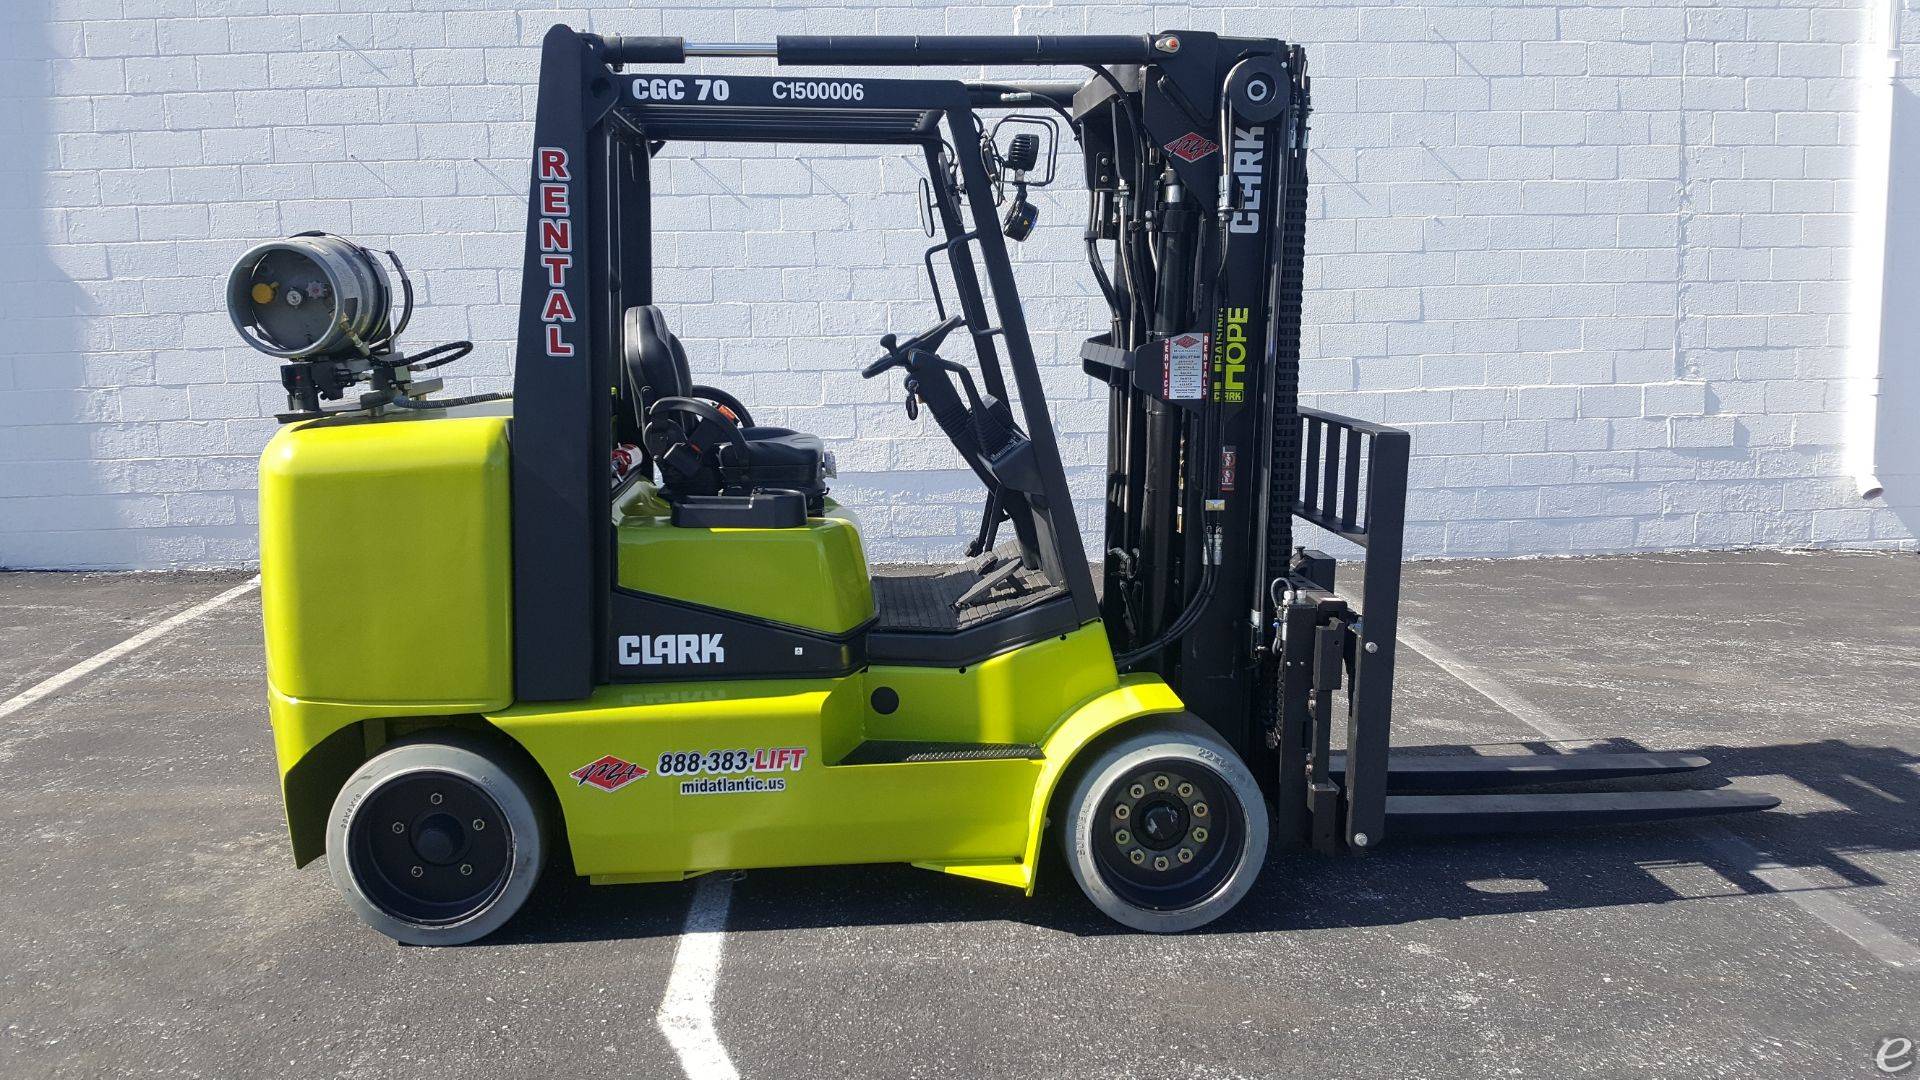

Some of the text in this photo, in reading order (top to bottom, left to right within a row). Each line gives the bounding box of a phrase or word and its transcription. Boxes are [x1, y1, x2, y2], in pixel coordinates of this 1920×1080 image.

[632, 79, 729, 101] CGC 70
[772, 81, 864, 102] C1500006
[1230, 127, 1264, 233] CLARK
[538, 147, 576, 357] RENTAL
[618, 633, 725, 665] CLARK
[682, 777, 784, 793] midatlantic.us
